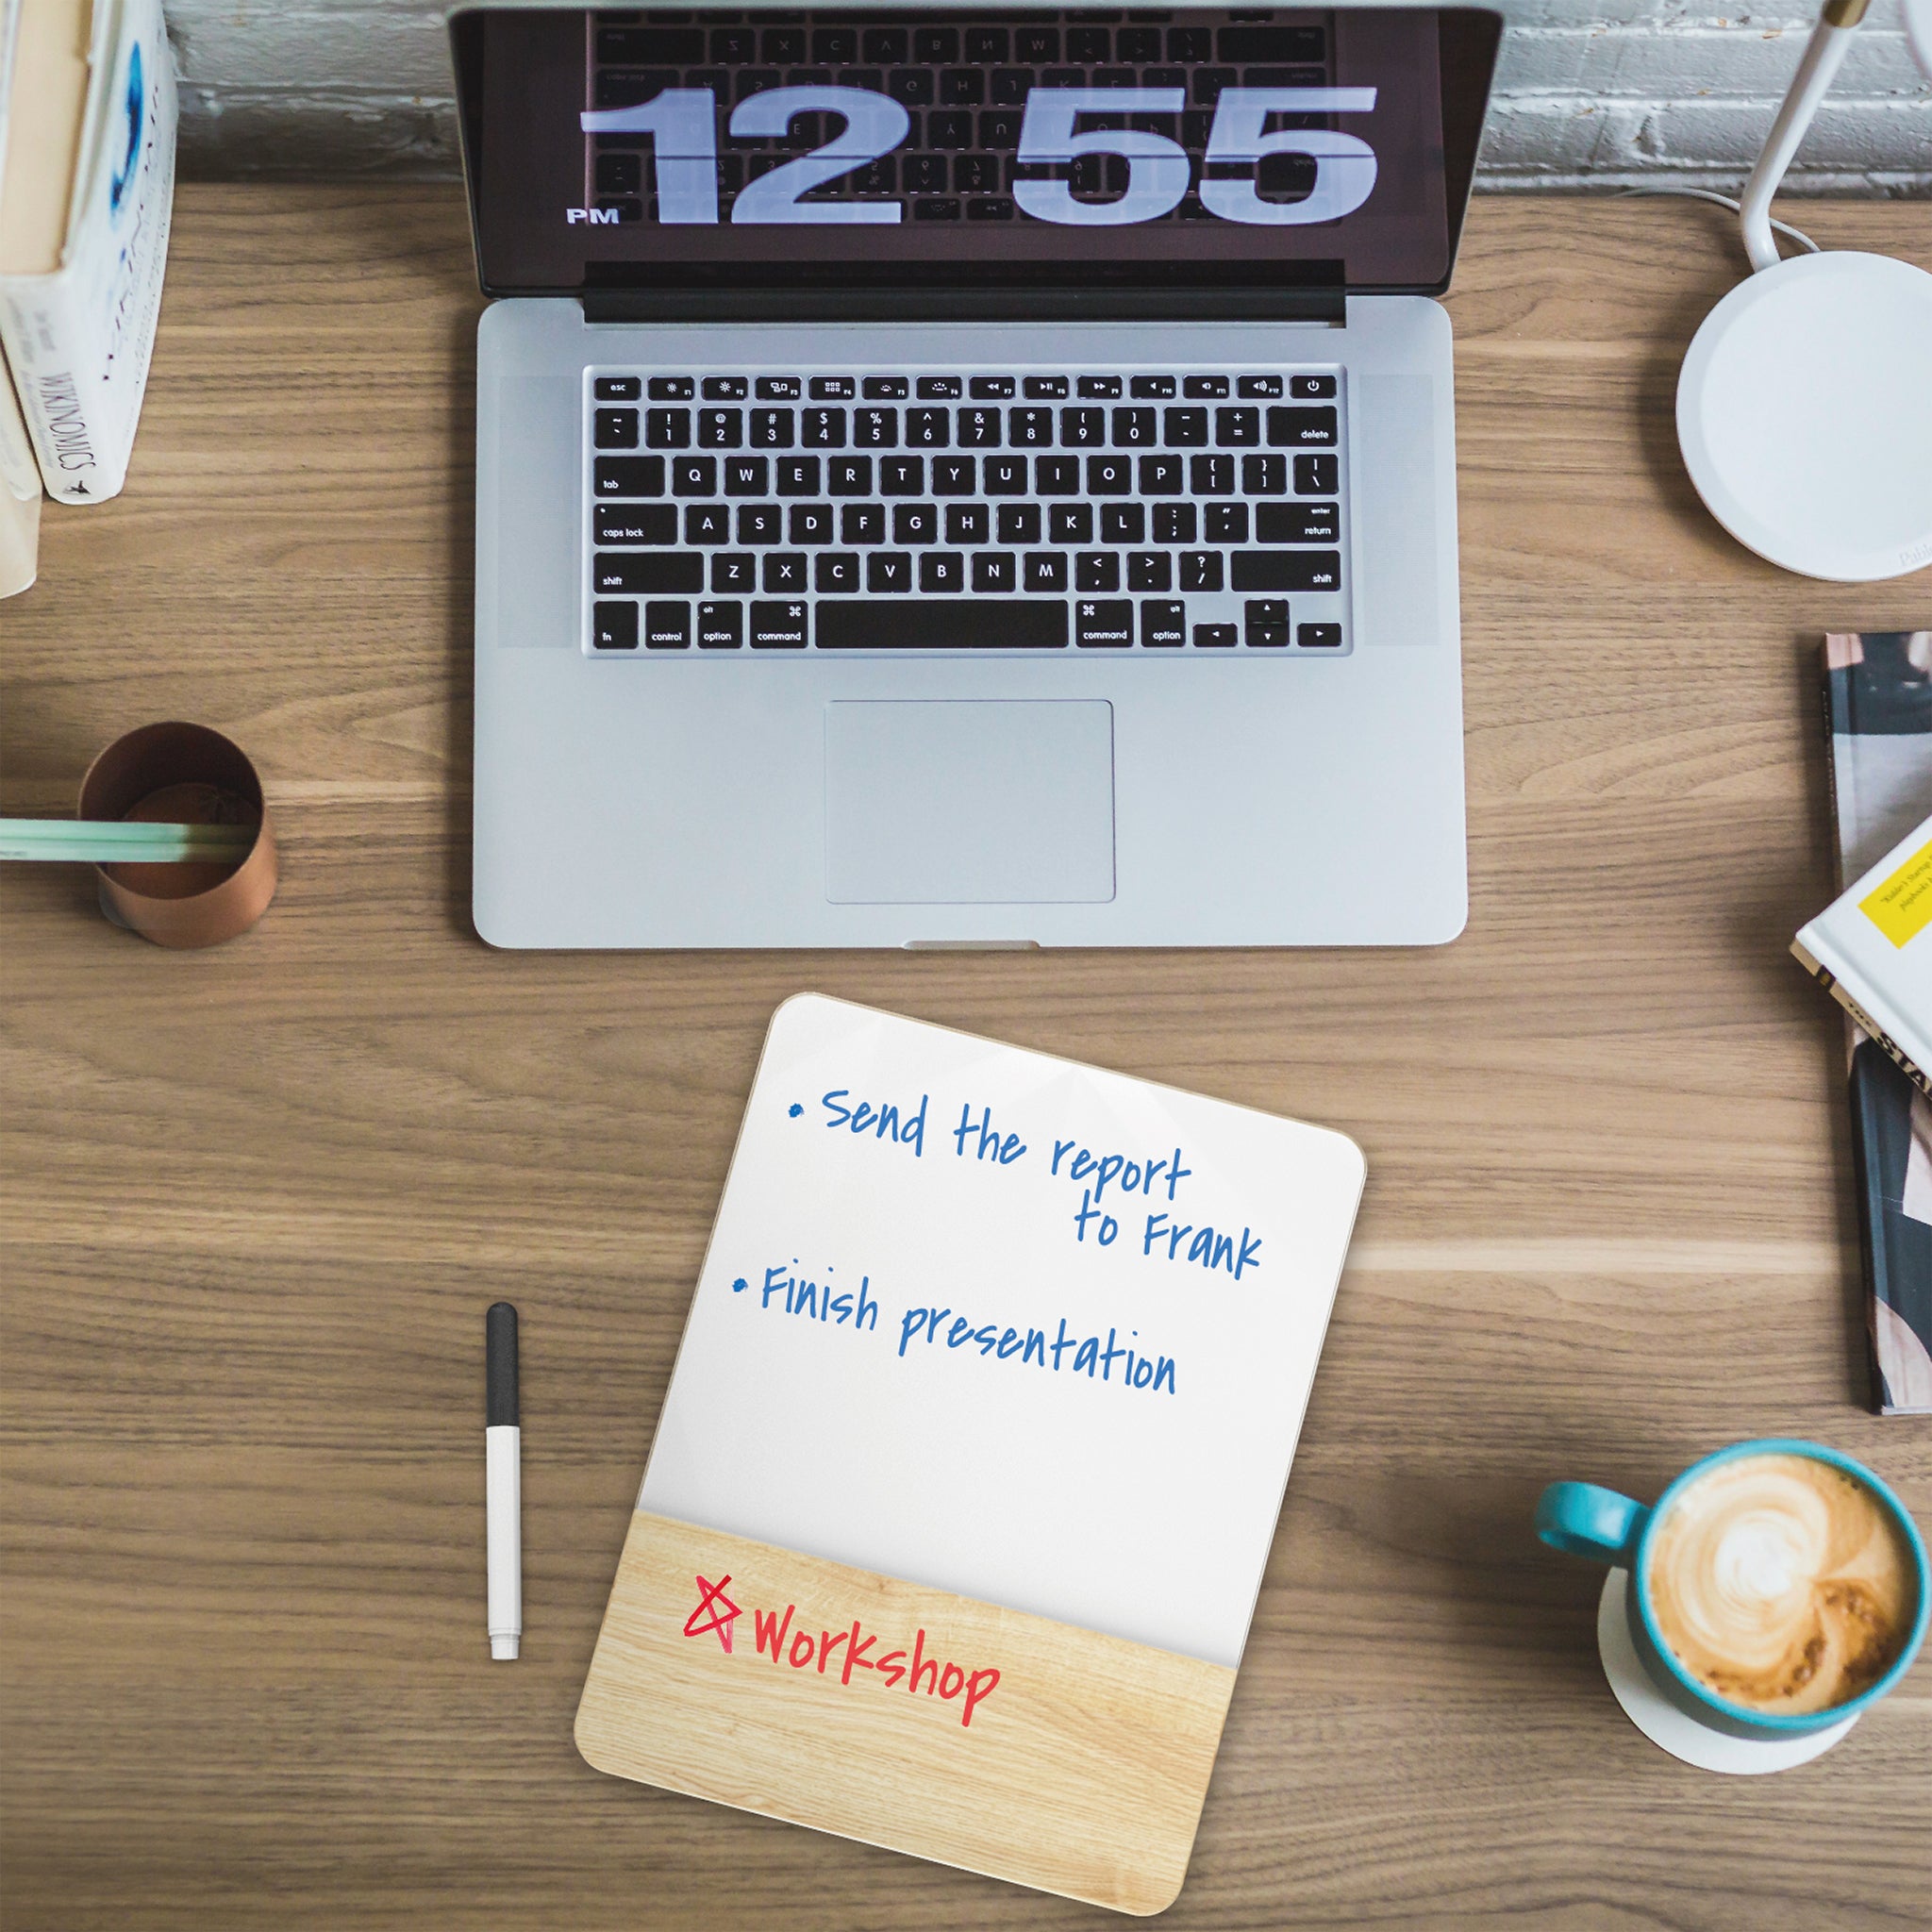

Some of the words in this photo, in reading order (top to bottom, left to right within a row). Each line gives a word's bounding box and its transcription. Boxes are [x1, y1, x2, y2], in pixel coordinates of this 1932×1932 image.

[580, 85, 911, 225] 12
[1012, 87, 1378, 226] 55
[566, 208, 620, 225] PM
[40, 373, 97, 471] WIKINOMICS
[667, 413, 672, 425] !
[714, 413, 726, 424] @
[768, 413, 777, 425] #
[820, 411, 828, 425] $
[869, 412, 883, 425] %
[923, 412, 932, 421] ^
[974, 411, 985, 425] &
[1080, 411, 1086, 424] (
[1132, 411, 1137, 424] )
[1233, 412, 1243, 422] +
[665, 428, 672, 441] 1
[716, 428, 725, 441] 2
[767, 428, 777, 441] 3
[819, 427, 829, 441] 4
[872, 427, 880, 441] 5
[924, 427, 932, 441] 6
[974, 427, 984, 441] 7
[1026, 427, 1036, 440] 8
[1078, 427, 1088, 440] 9
[1129, 427, 1140, 440] 0
[1300, 429, 1329, 440] delete
[1209, 458, 1216, 473] {
[1261, 458, 1268, 472] }
[689, 468, 702, 482] Q
[739, 469, 754, 482] W
[793, 468, 803, 482] E
[845, 468, 856, 482] R
[897, 467, 907, 481] T
[949, 467, 960, 481] Y
[1000, 467, 1012, 481] U
[1056, 467, 1060, 481] I
[1103, 467, 1116, 480] O
[1157, 466, 1167, 480] P
[603, 479, 620, 490] tab
[1210, 475, 1216, 488] [
[1262, 475, 1267, 488] ]
[1311, 475, 1321, 488] \
[702, 516, 714, 530] A
[755, 517, 765, 530] S
[806, 516, 818, 530] D
[859, 516, 868, 530] F
[909, 516, 922, 530] G
[961, 516, 974, 529] H
[1014, 515, 1023, 529] J
[1066, 515, 1077, 529] K
[1119, 515, 1128, 529] L
[602, 529, 625, 539] caps
[625, 527, 644, 538] lock
[1304, 526, 1332, 536] return
[1092, 558, 1103, 568] <
[1145, 558, 1155, 568] >
[1197, 556, 1207, 568] ?
[728, 564, 740, 578] Z
[780, 564, 792, 578] X
[832, 564, 843, 578] C
[884, 564, 896, 578] V
[937, 564, 947, 578] B
[988, 564, 1000, 577] N
[1039, 563, 1054, 577] M
[602, 575, 623, 586] shift
[1197, 573, 1206, 584] /
[1312, 574, 1333, 584] shift
[602, 631, 612, 641] fn
[651, 631, 682, 641] control
[703, 632, 732, 642] option
[757, 631, 802, 641] command
[1082, 629, 1128, 641] command
[1152, 630, 1181, 641] option
[1876, 1031, 1932, 1102] STA
[822, 1090, 928, 1158] Send
[953, 1103, 1027, 1165] the
[1051, 1140, 1191, 1204] report
[1074, 1189, 1119, 1246] to
[1143, 1213, 1262, 1281] Frank
[762, 1257, 878, 1331] Finish
[898, 1307, 1175, 1395] presentation
[754, 1604, 1001, 1727] Workshop
